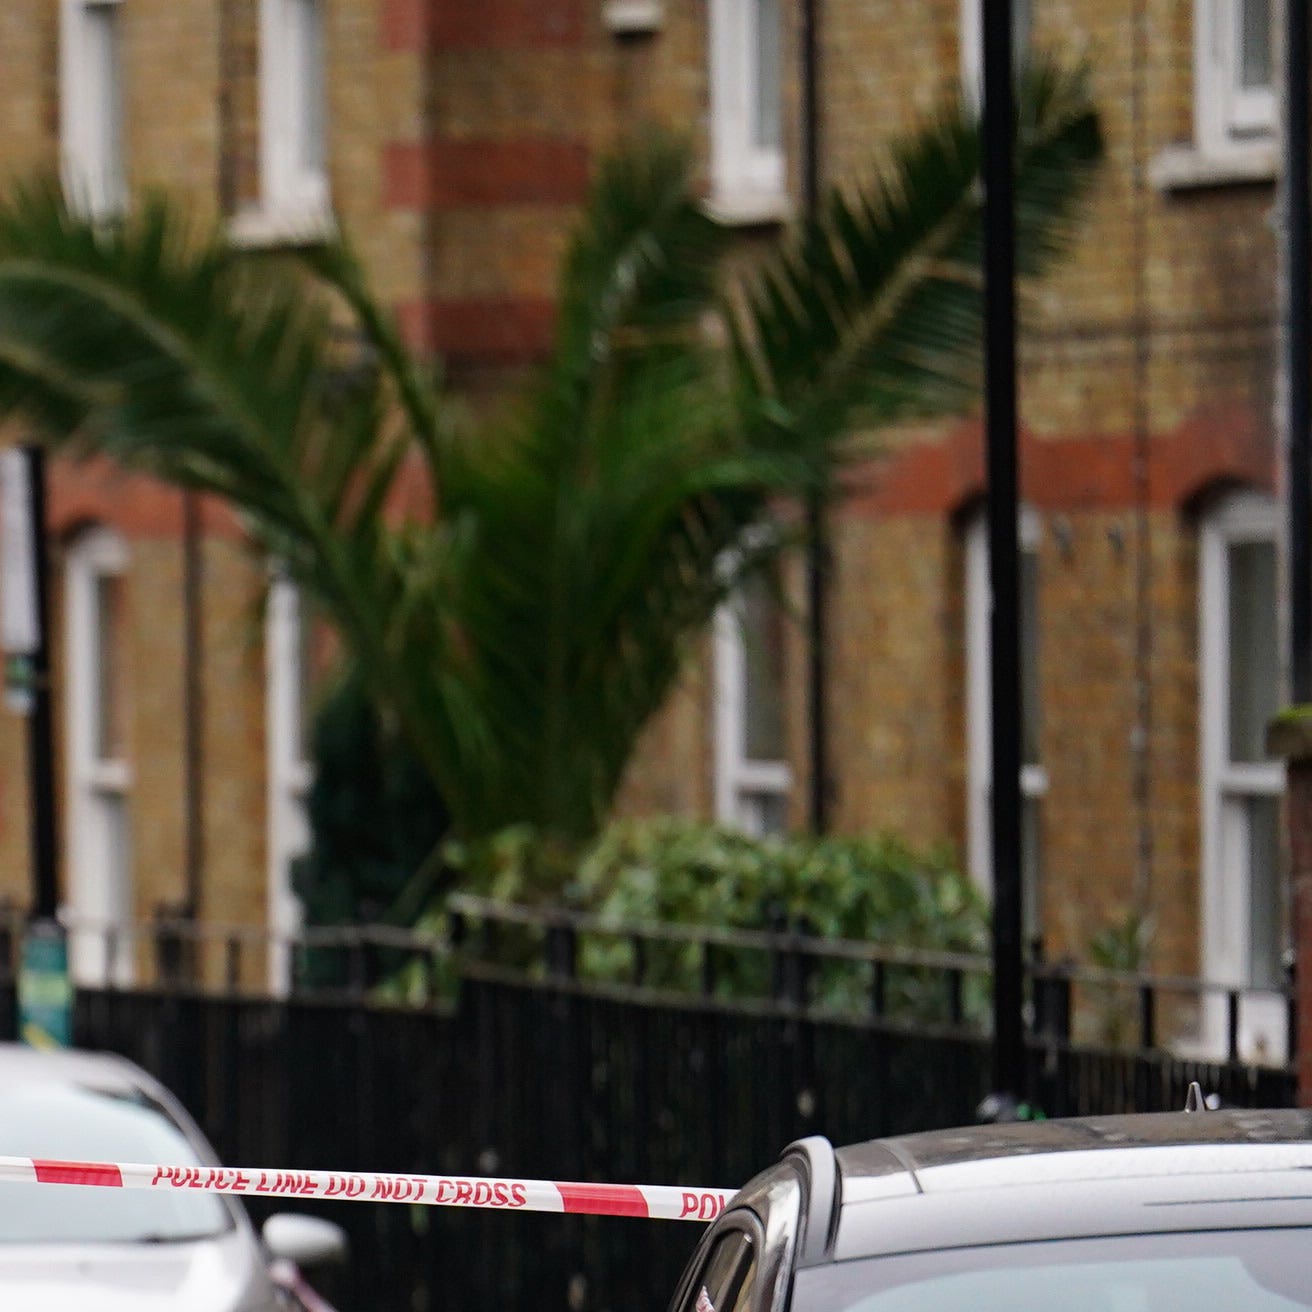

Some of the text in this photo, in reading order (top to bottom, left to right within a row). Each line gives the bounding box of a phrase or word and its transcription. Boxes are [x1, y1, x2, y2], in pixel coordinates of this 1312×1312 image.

[151, 1166, 527, 1208] POLICE LINE DO NOT CROSS
